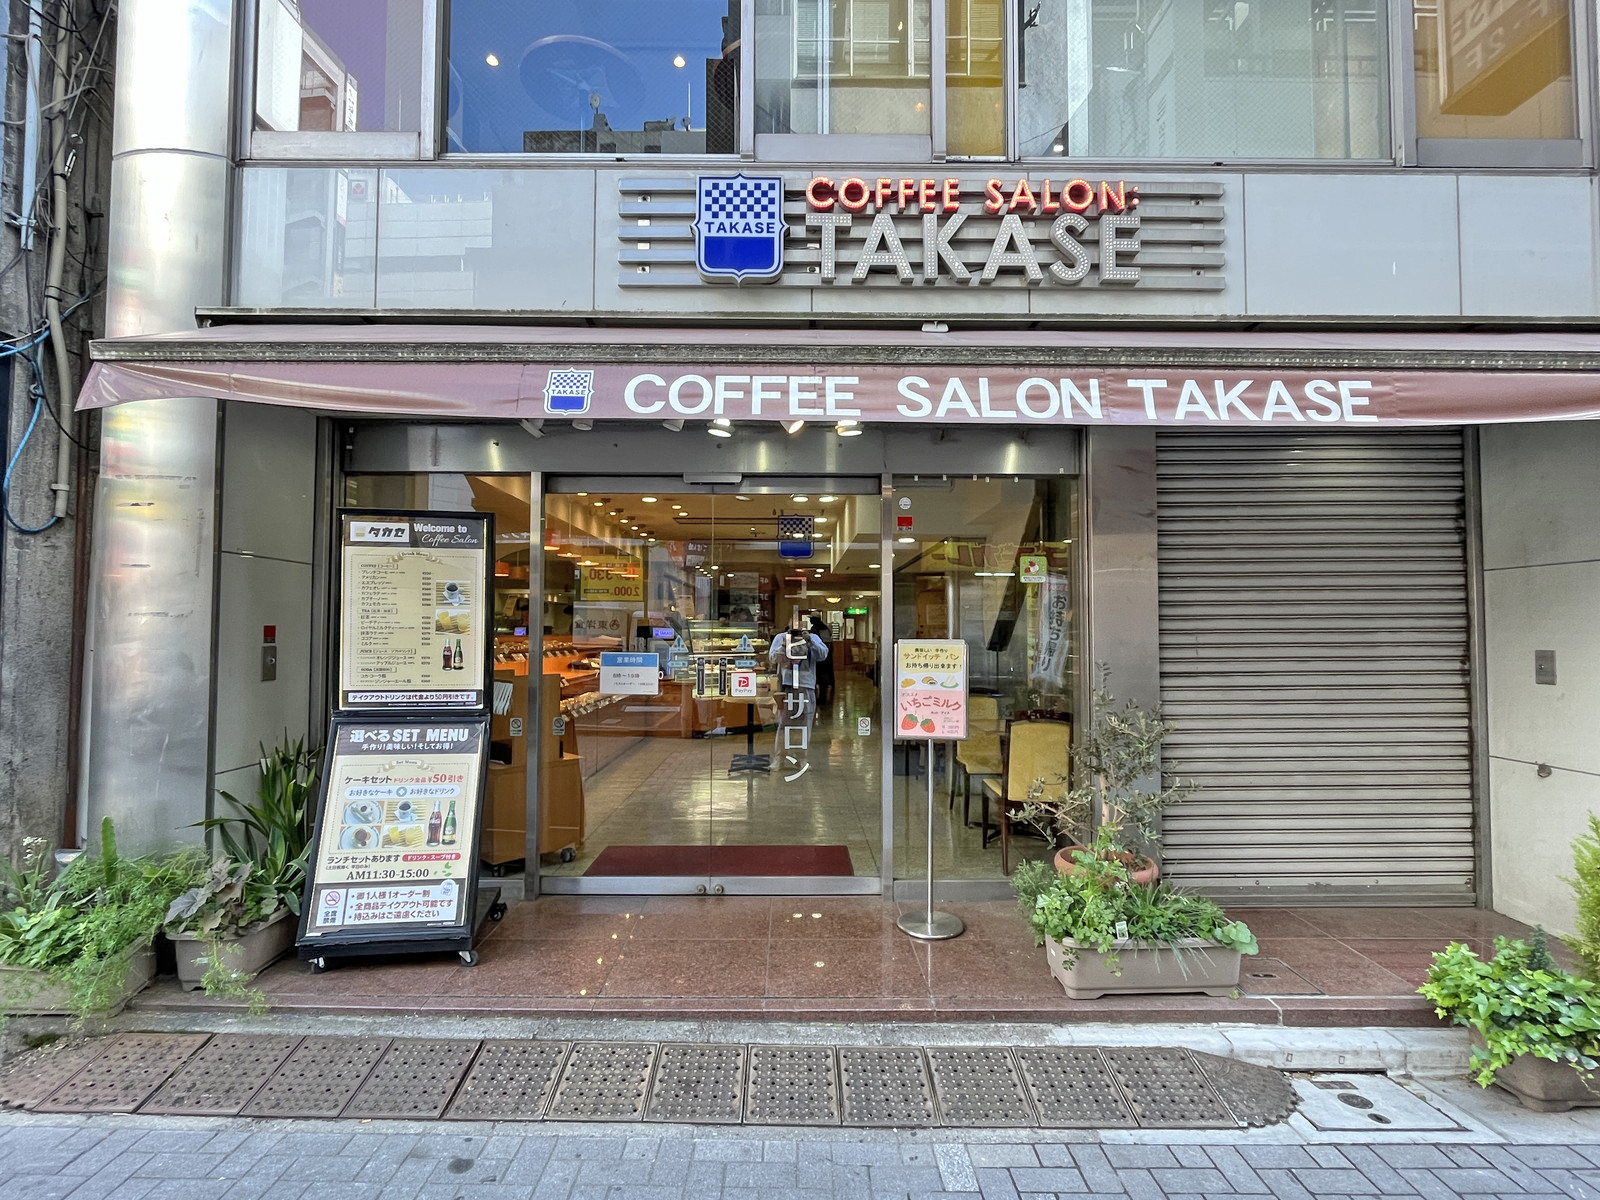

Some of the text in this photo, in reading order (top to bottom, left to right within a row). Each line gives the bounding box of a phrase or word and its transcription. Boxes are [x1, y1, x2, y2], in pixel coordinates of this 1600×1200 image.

[805, 176, 961, 213] COFFEE
[704, 222, 776, 234] TAKASE
[805, 213, 1142, 285] TAKASE
[624, 373, 1380, 423] COFFEE SALON TAKASE
[413, 523, 468, 533] Welcome to
[421, 533, 479, 547] Coffee Salon
[616, 656, 643, 664] 営業時間
[900, 695, 962, 711] いちごミルク
[350, 728, 469, 743] 選べる SET MENU
[344, 775, 392, 785] ケーキセット
[327, 854, 400, 865] ランチセットあります
